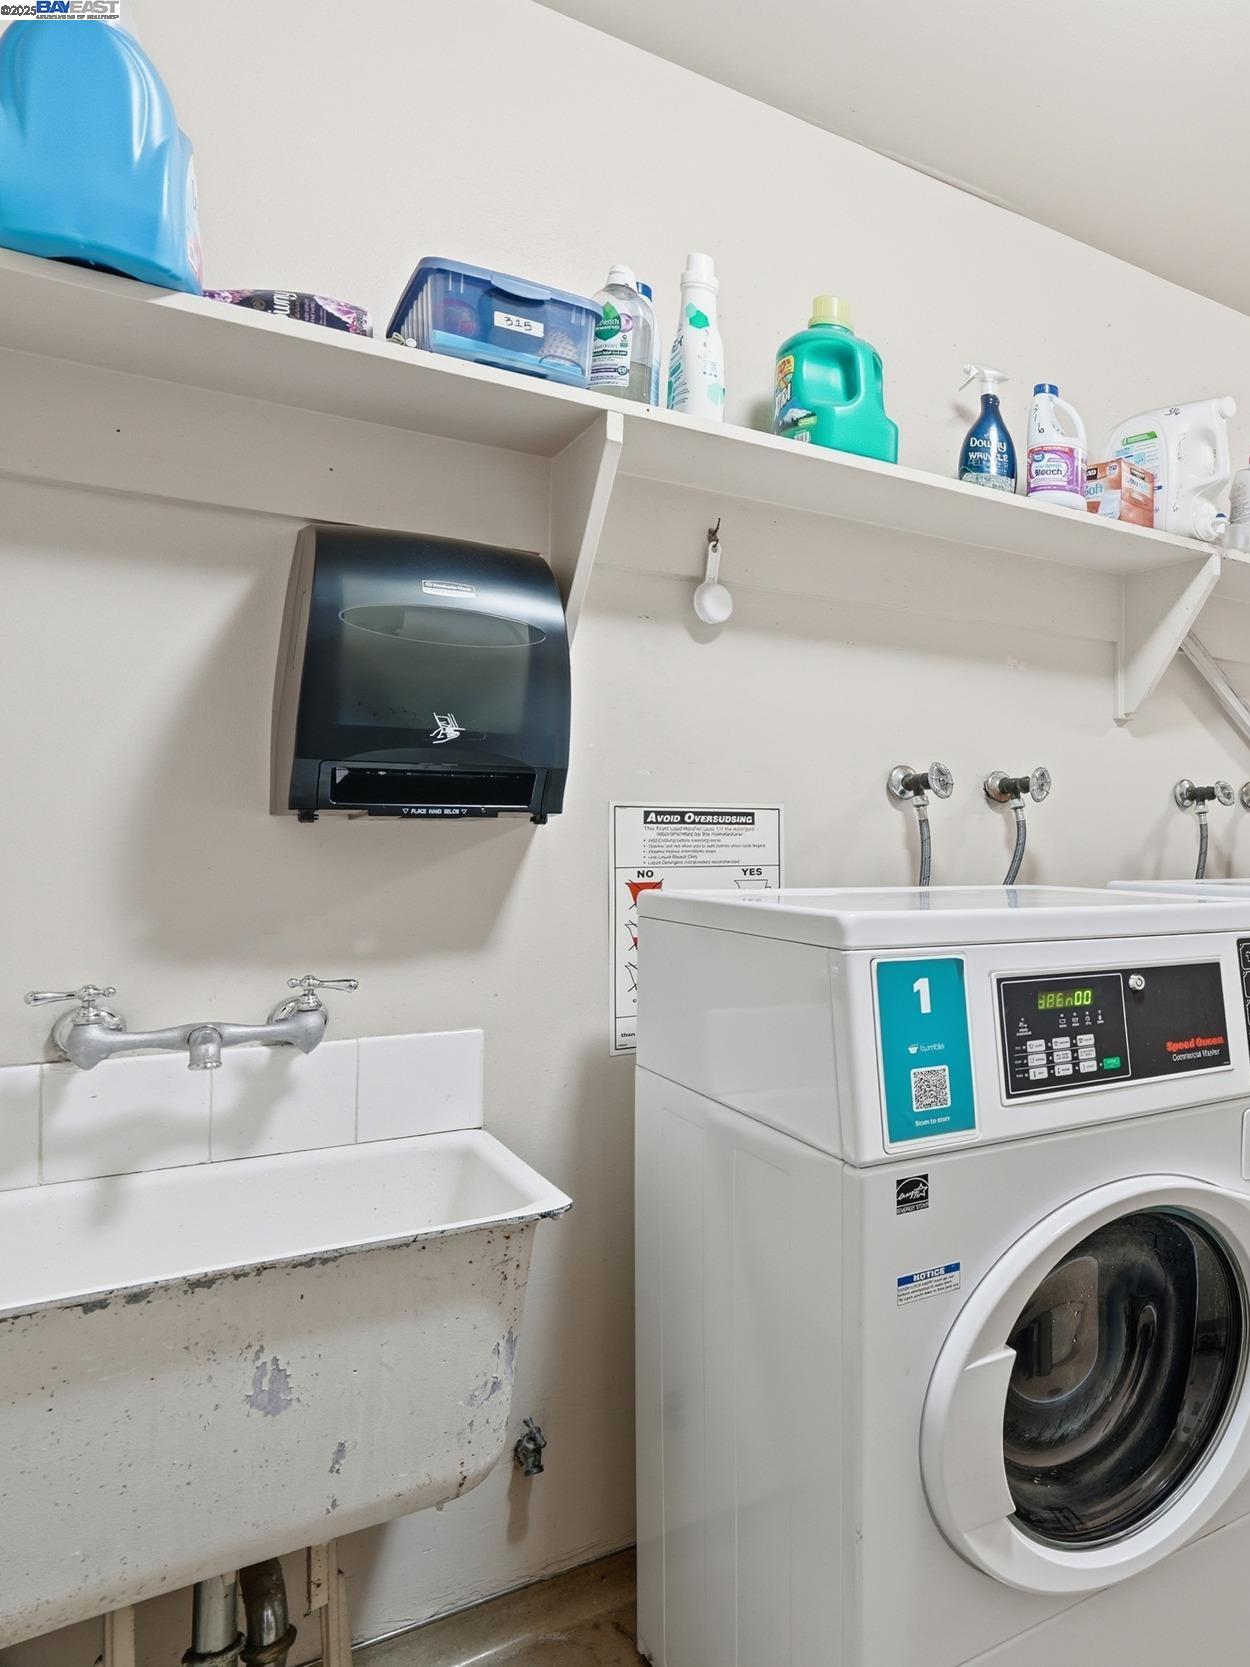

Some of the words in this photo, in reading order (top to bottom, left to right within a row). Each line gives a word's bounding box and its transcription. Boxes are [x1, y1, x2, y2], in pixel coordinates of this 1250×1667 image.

[504, 316, 532, 330] 315
[646, 812, 680, 822] AVOID
[684, 812, 752, 823] OVERSUDSING
[637, 870, 654, 878] NO
[914, 978, 932, 1014] 1
[1166, 1038, 1195, 1052] Speed
[1196, 1036, 1224, 1048] Queen
[1172, 1051, 1201, 1062] Commercial
[914, 1118, 929, 1127] Scan
[913, 1268, 945, 1281] NOTICE
